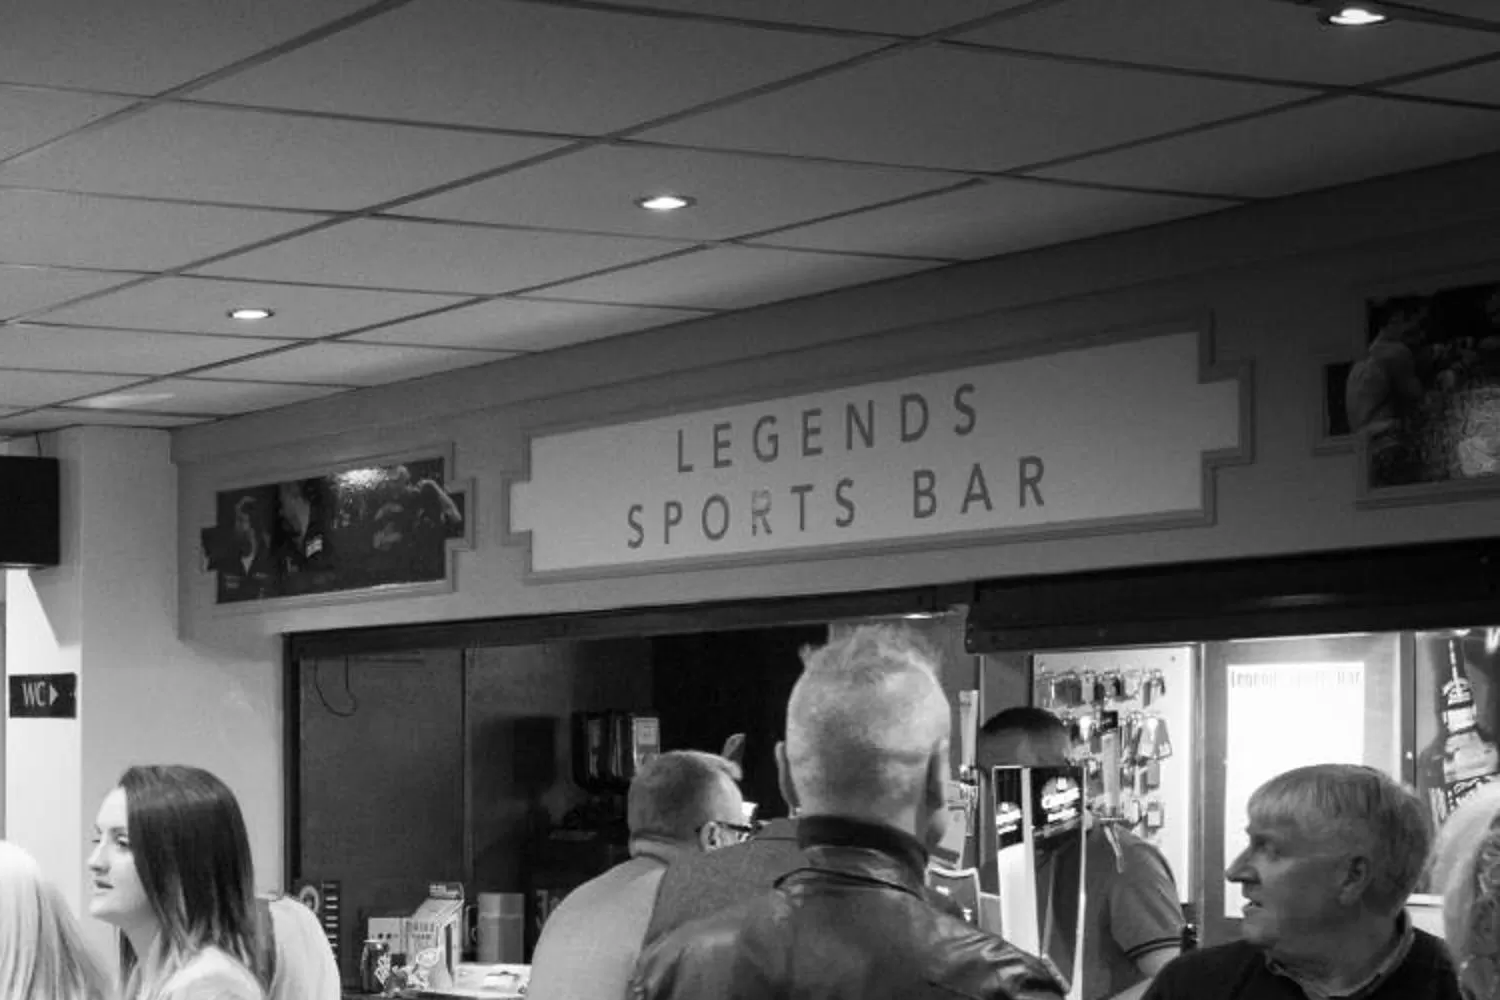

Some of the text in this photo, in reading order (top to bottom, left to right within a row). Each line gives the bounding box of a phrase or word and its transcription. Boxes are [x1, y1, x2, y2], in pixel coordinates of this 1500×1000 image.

[676, 382, 977, 473] LEGENDS
[626, 455, 1045, 550] SPORTS BAR
[21, 681, 47, 707] WC
